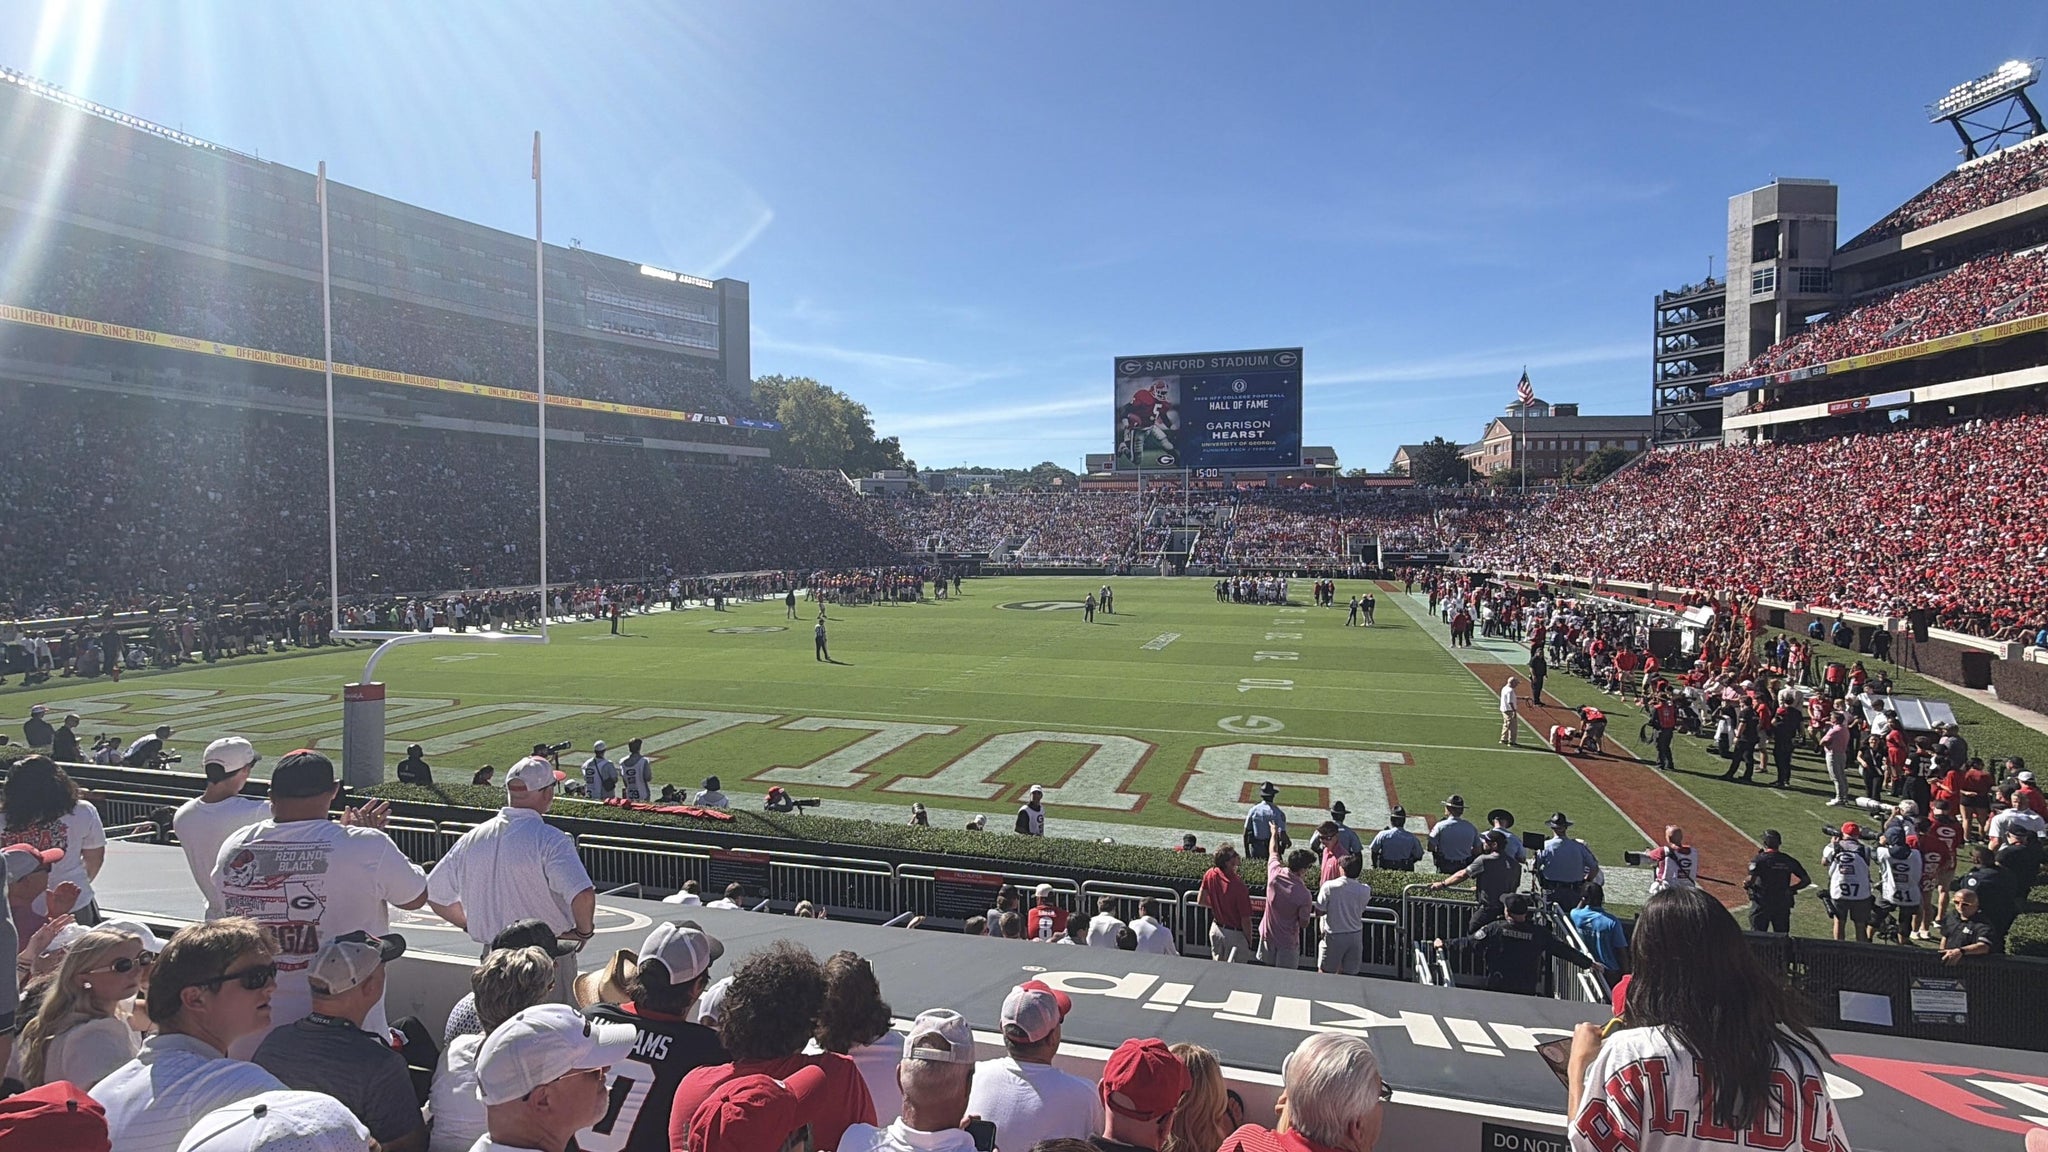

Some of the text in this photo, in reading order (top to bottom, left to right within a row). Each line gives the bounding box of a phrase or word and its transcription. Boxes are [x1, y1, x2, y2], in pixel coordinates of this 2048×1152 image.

[59, 316, 98, 333] FLAVOR
[102, 325, 132, 339] SINCE
[135, 330, 157, 343] 1947
[1993, 324, 2014, 337] TRUE
[1898, 343, 1929, 358] SAUSAGE
[236, 347, 272, 363] OFFICIAL
[275, 353, 307, 368] SMOKED
[346, 365, 355, 375] OF
[358, 367, 370, 378] THE
[373, 370, 402, 382] GEORGIA
[404, 375, 438, 387] BULLDOGS
[1146, 358, 1205, 371] SANFORD
[1211, 355, 1269, 368] STADIUM
[1209, 399, 1269, 411] HALL OF FAME
[1206, 420, 1271, 430] GARRISON
[1212, 430, 1265, 439] HEARST
[1196, 469, 1218, 477] 15:00
[275, 849, 322, 861] RED AND
[278, 861, 314, 872] BLACK
[1839, 883, 1859, 897] 97
[1502, 928, 1533, 941] SHERIFF
[1494, 1132, 1519, 1150] DO
[1523, 1137, 1561, 1152] NOT
